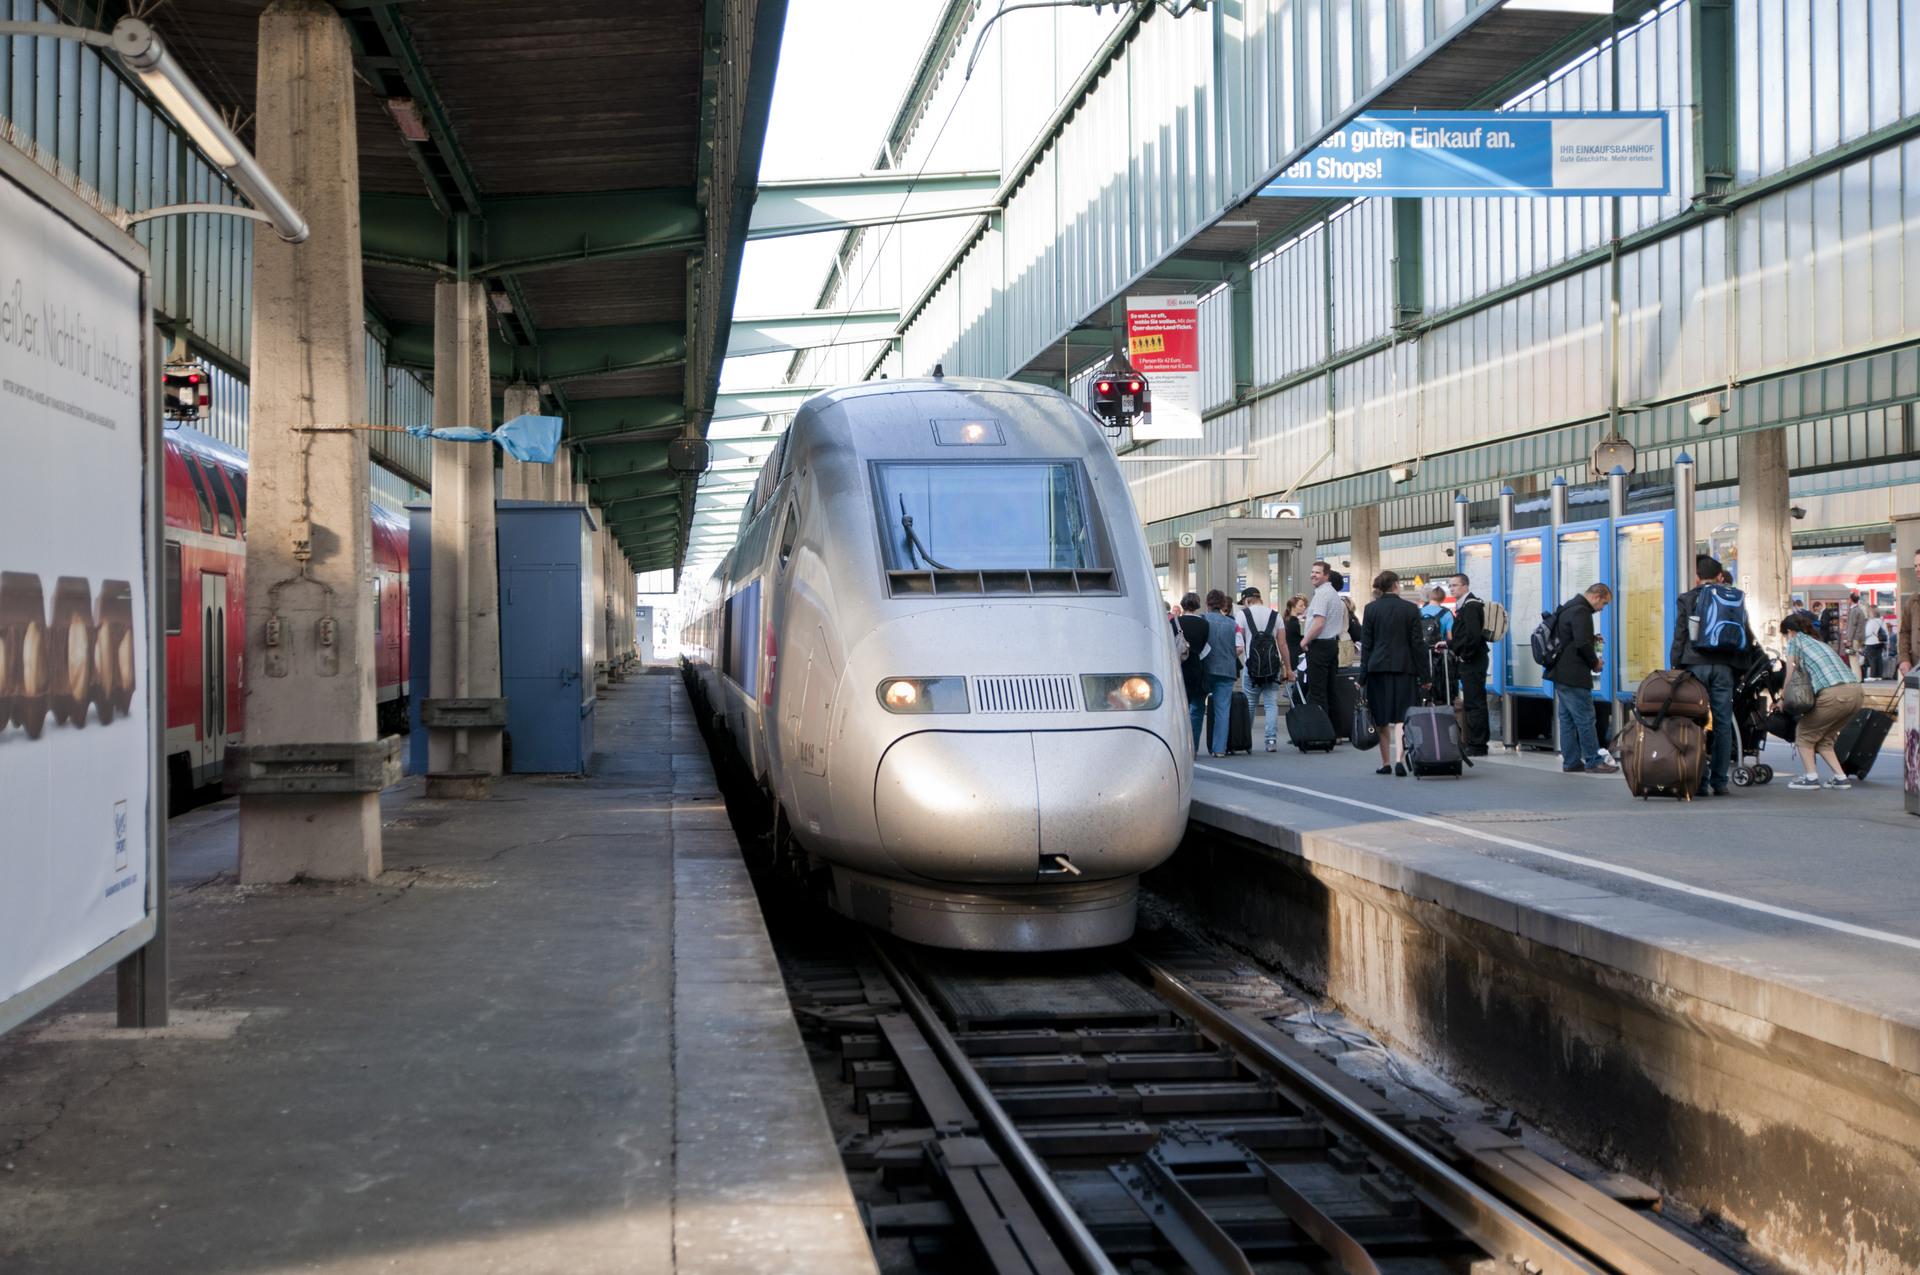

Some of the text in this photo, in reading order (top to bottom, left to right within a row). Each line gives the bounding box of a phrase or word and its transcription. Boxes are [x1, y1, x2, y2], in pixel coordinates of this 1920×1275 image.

[1319, 126, 1516, 152] en guten Einkauf an.
[1559, 144, 1655, 155] IHR EINKAUFSBAHNHOF
[1280, 157, 1382, 184] en Shops!
[1559, 155, 1575, 163] Gute
[0, 278, 135, 398] eißer. Nicht für Lutscher.
